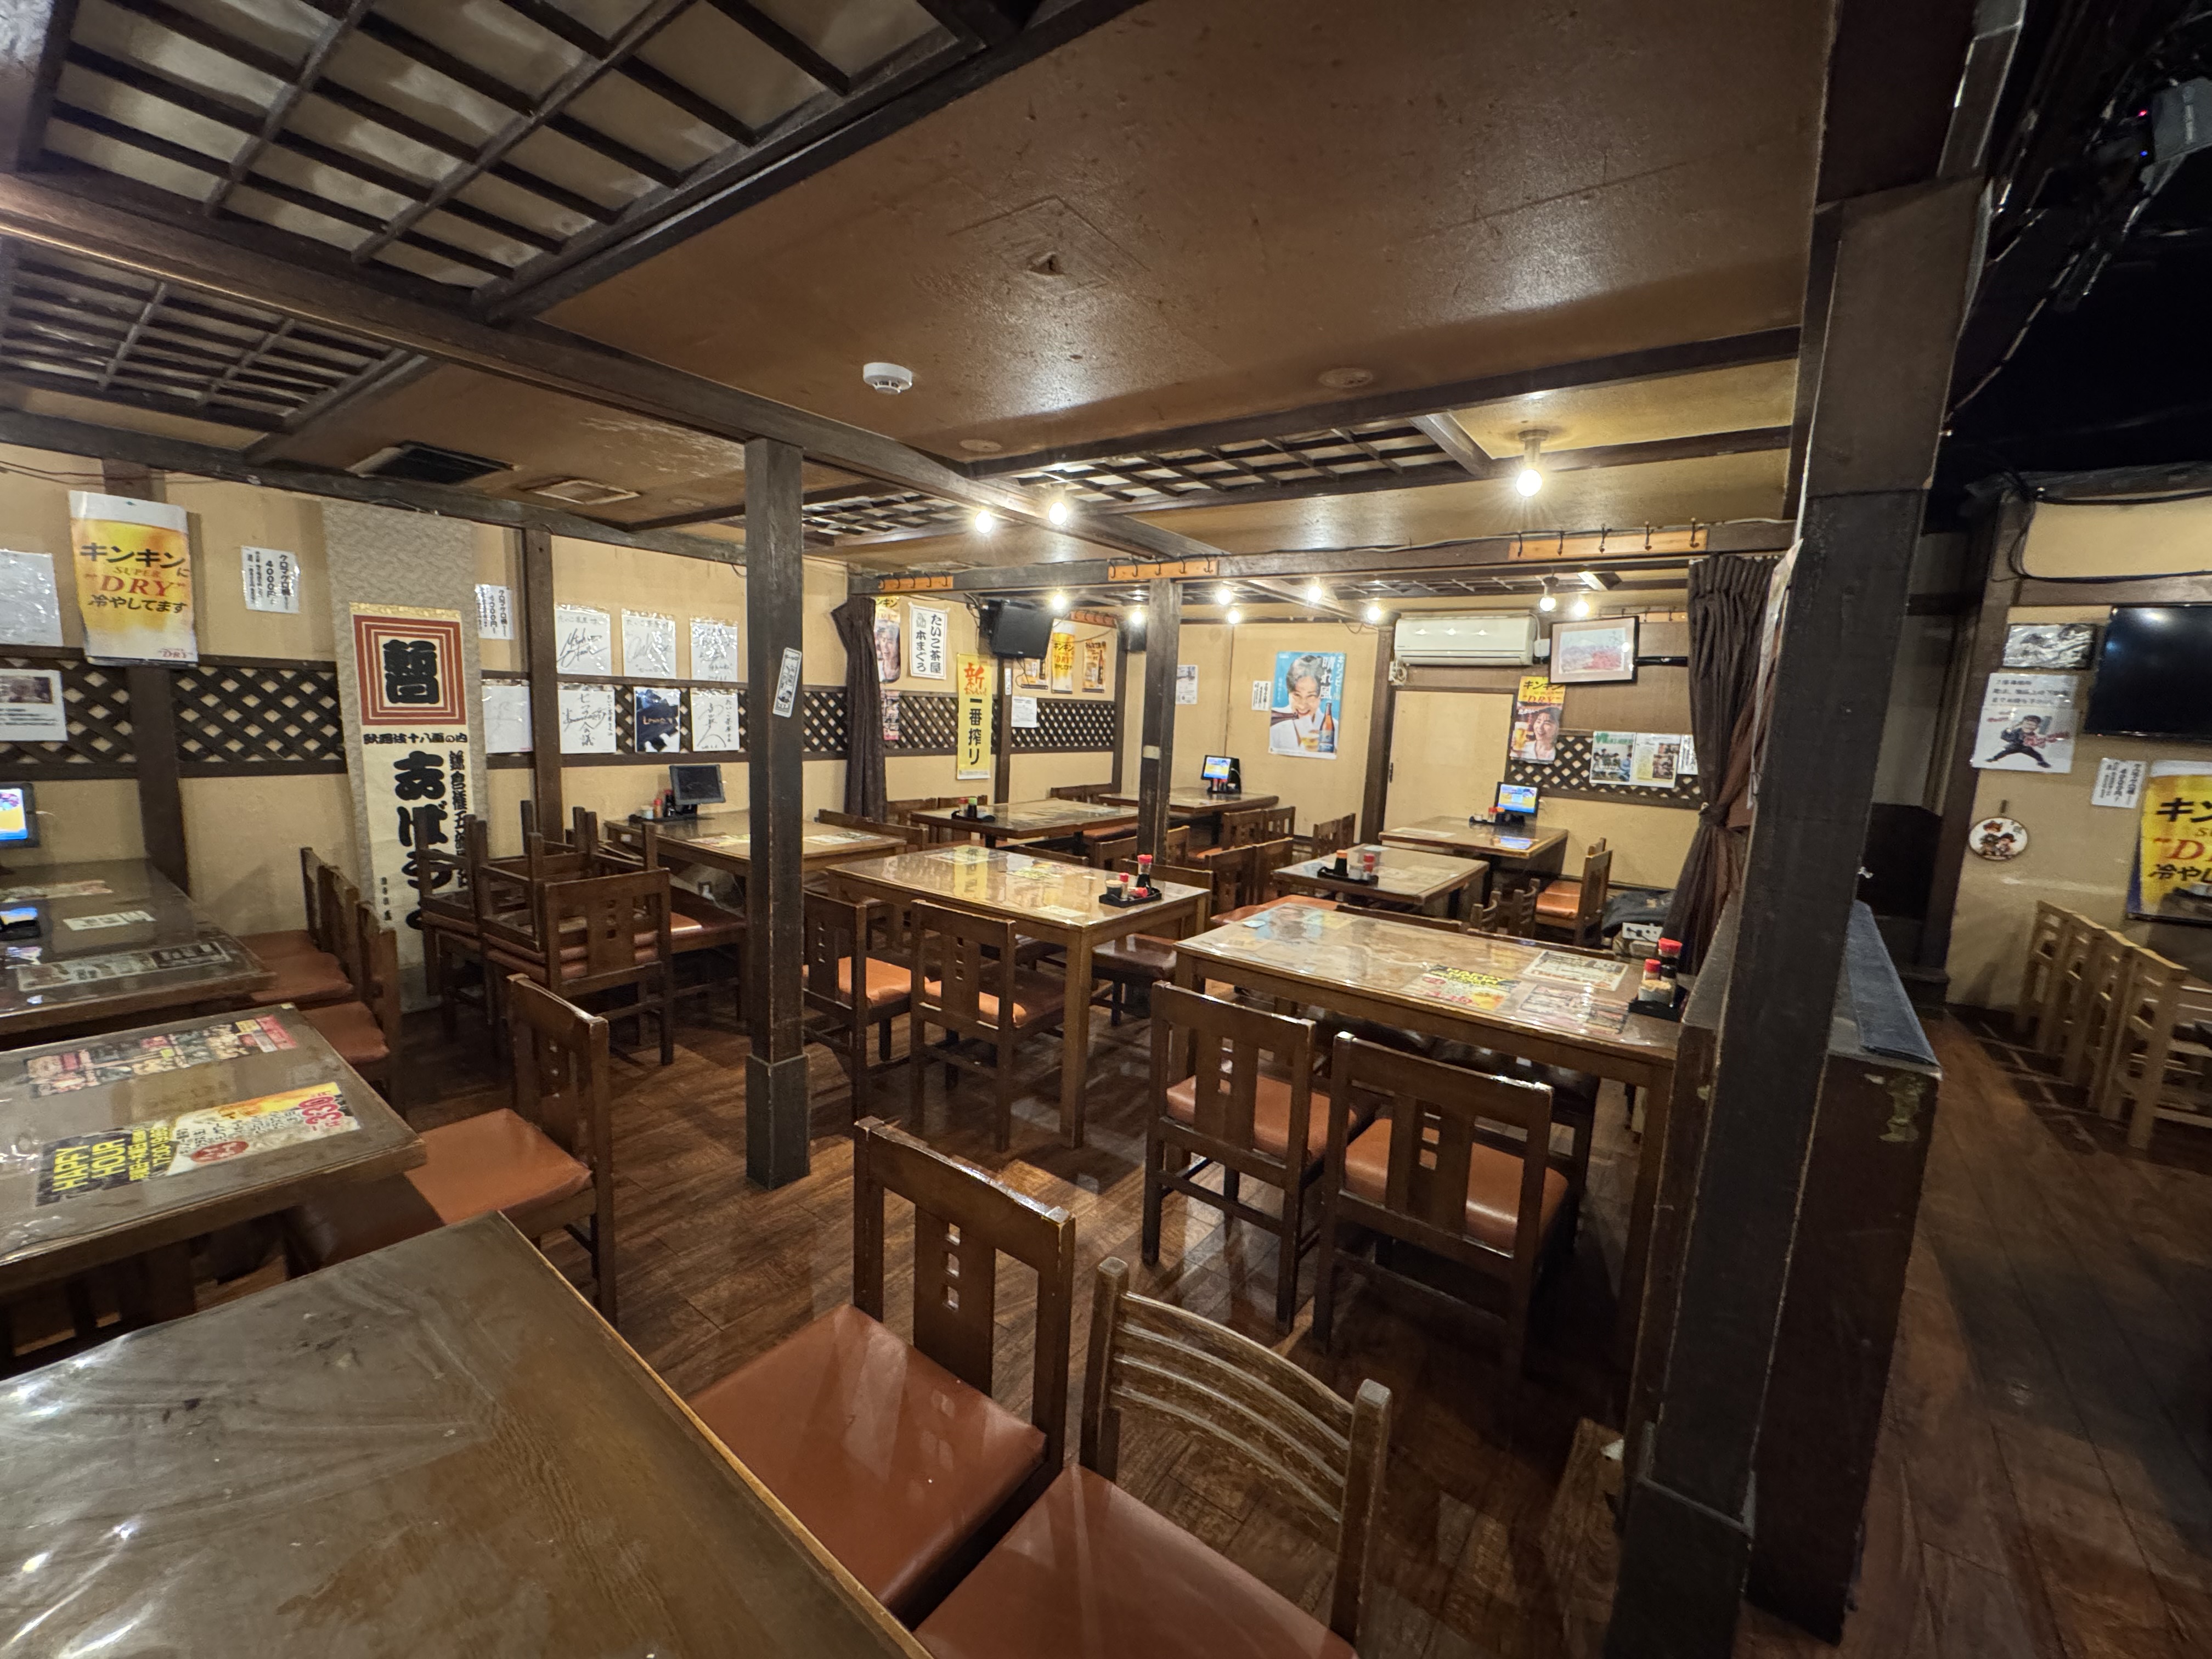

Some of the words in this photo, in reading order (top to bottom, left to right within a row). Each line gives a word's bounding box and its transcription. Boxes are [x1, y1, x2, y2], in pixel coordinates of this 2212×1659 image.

[100, 575, 174, 597] DRY
[114, 566, 161, 576] SUPER
[88, 594, 188, 613] 冷やしてます
[916, 630, 927, 672] 本まぐろ
[930, 614, 943, 674] たいこ茶屋
[964, 662, 985, 690] 新
[1320, 656, 1336, 699] 晴れ風
[968, 698, 983, 765] 一番搾り
[52, 1144, 90, 1192] HAPPY
[91, 1138, 127, 1178] HOUR
